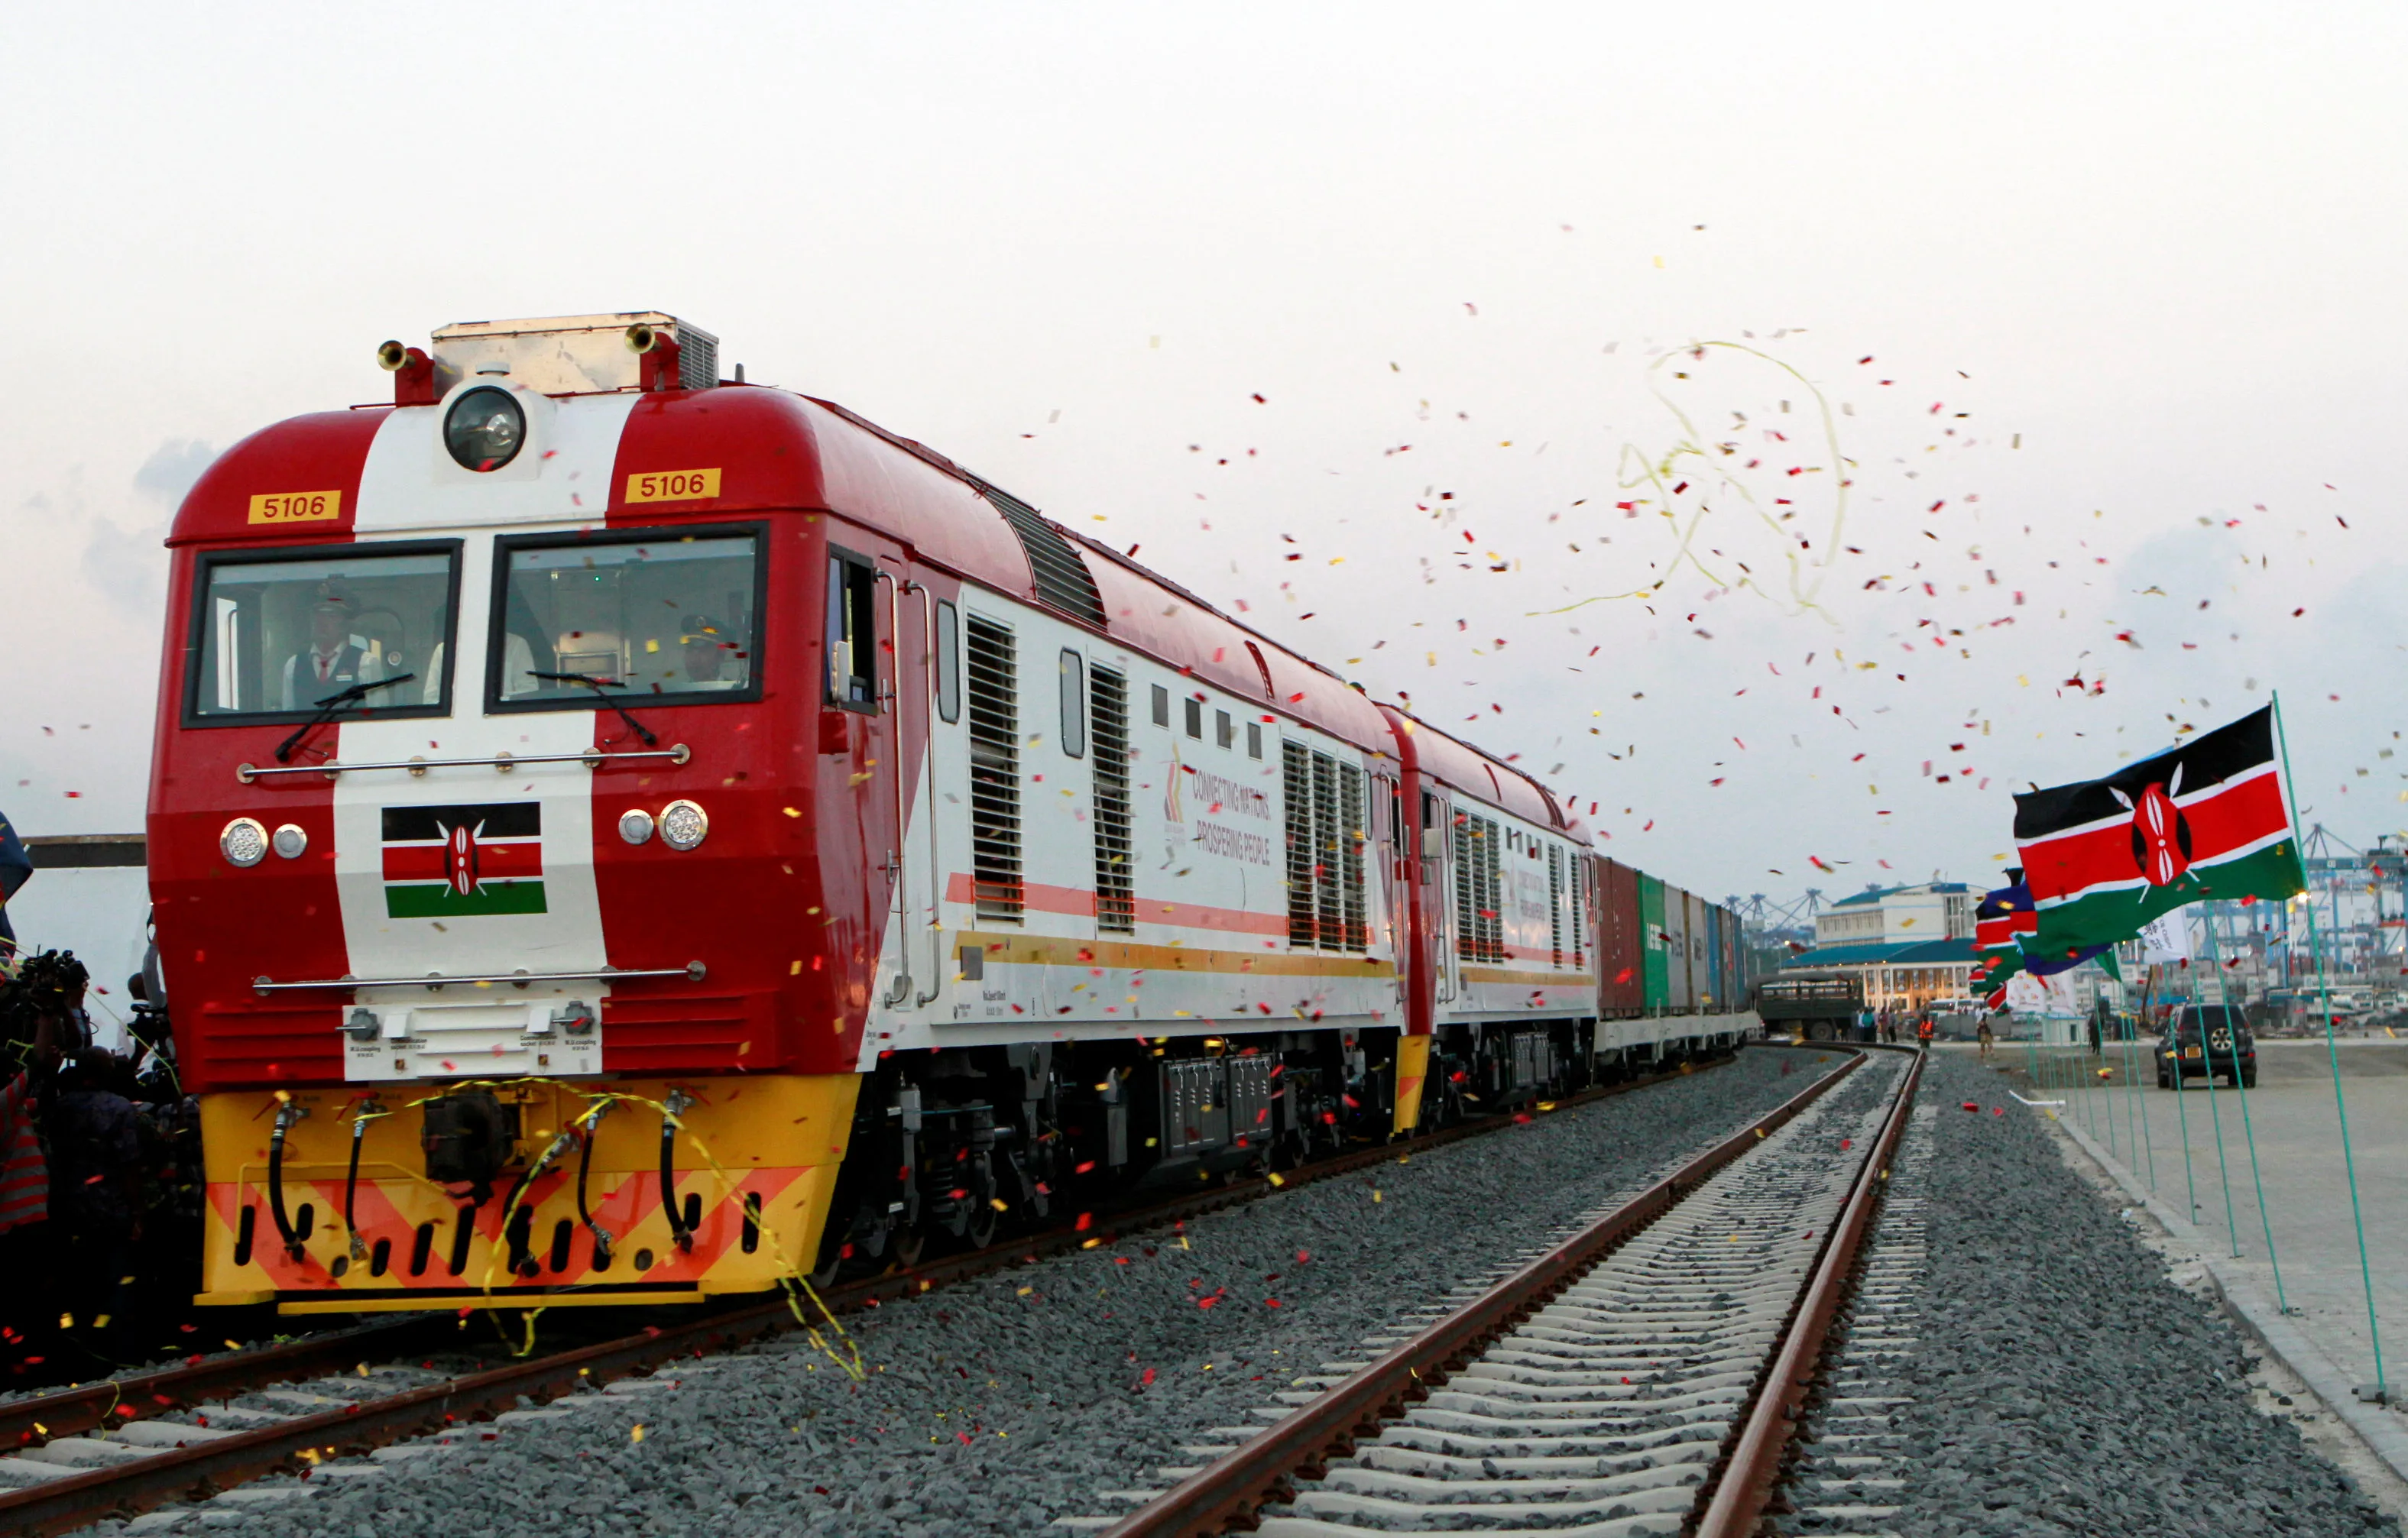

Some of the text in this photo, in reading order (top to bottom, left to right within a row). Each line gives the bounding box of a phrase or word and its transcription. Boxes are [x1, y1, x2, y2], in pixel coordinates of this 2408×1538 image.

[640, 474, 705, 497] 5106
[263, 496, 326, 518] 5106
[1192, 769, 1238, 812] CONNECTING
[1197, 820, 1270, 866] PROSPERING PEOPLE
